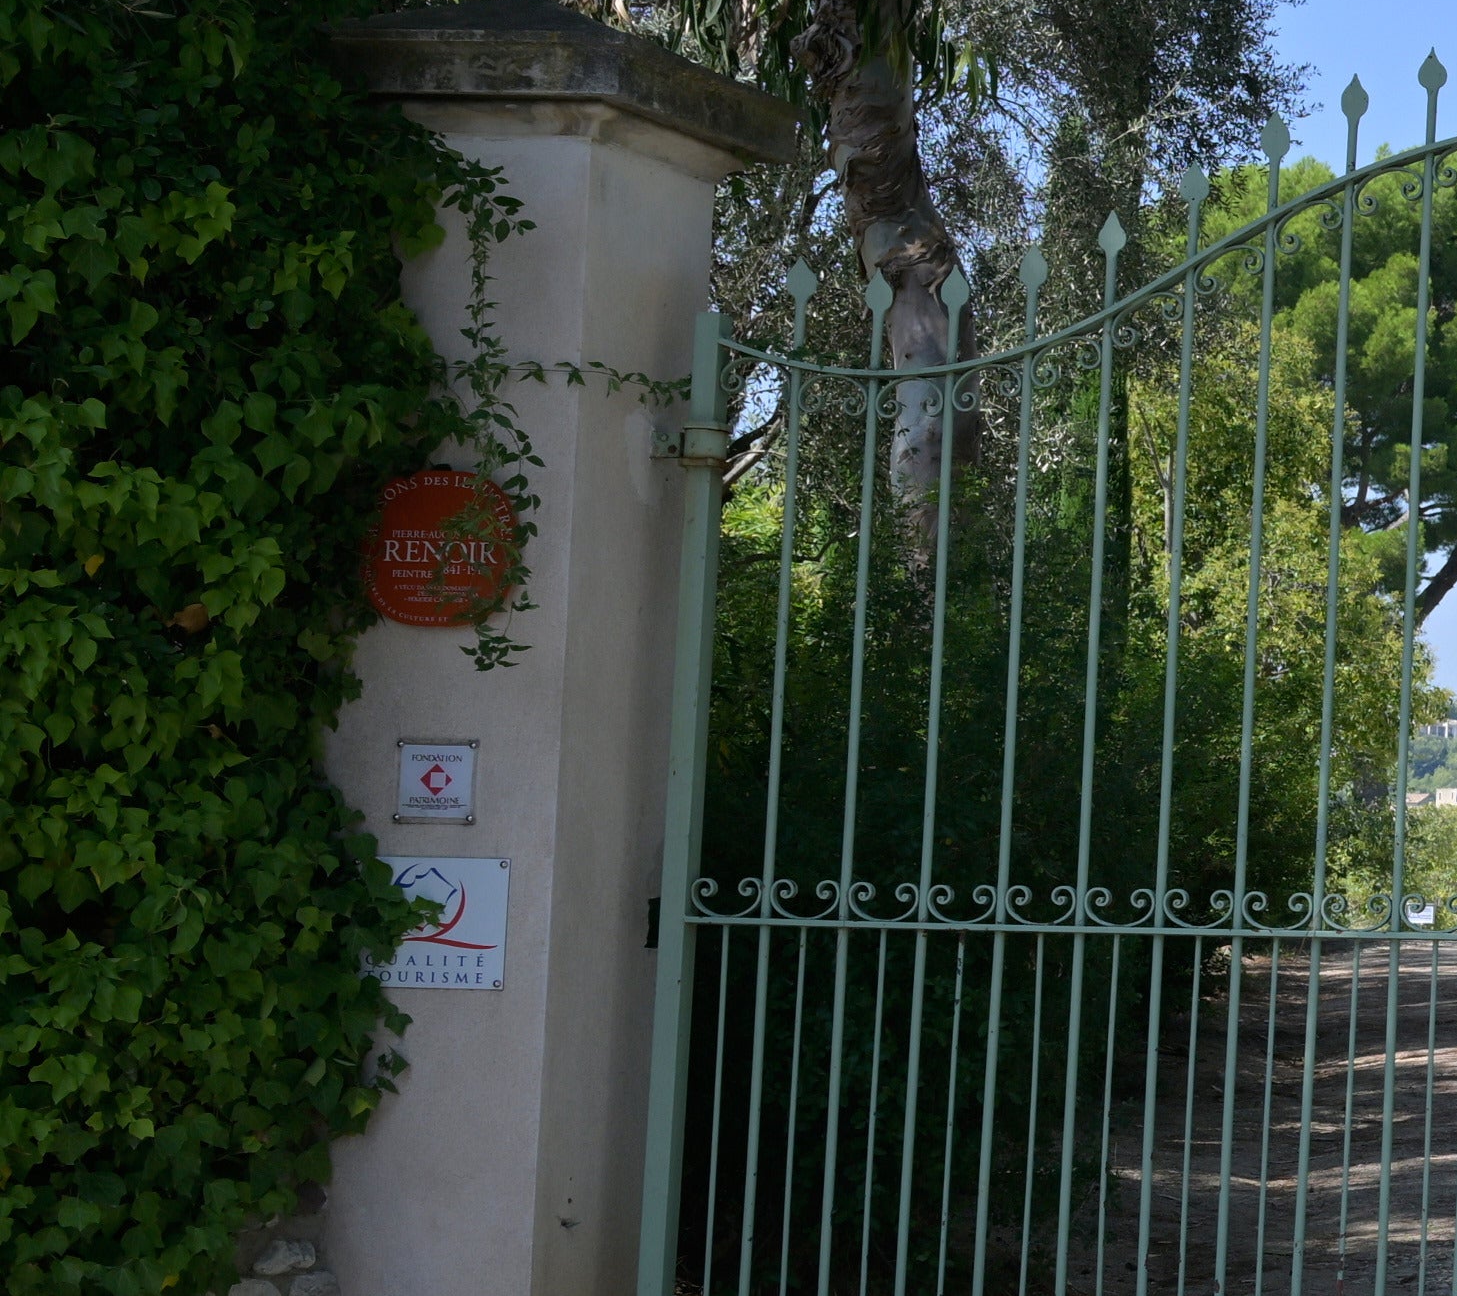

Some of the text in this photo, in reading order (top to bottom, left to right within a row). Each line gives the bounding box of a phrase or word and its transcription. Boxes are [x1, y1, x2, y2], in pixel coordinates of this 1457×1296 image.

[424, 476, 449, 486] DES
[383, 539, 498, 564] RENOIR
[392, 569, 433, 579] PEINTRE
[411, 753, 463, 762] FONDATION
[409, 796, 460, 804] PATRIMOINE
